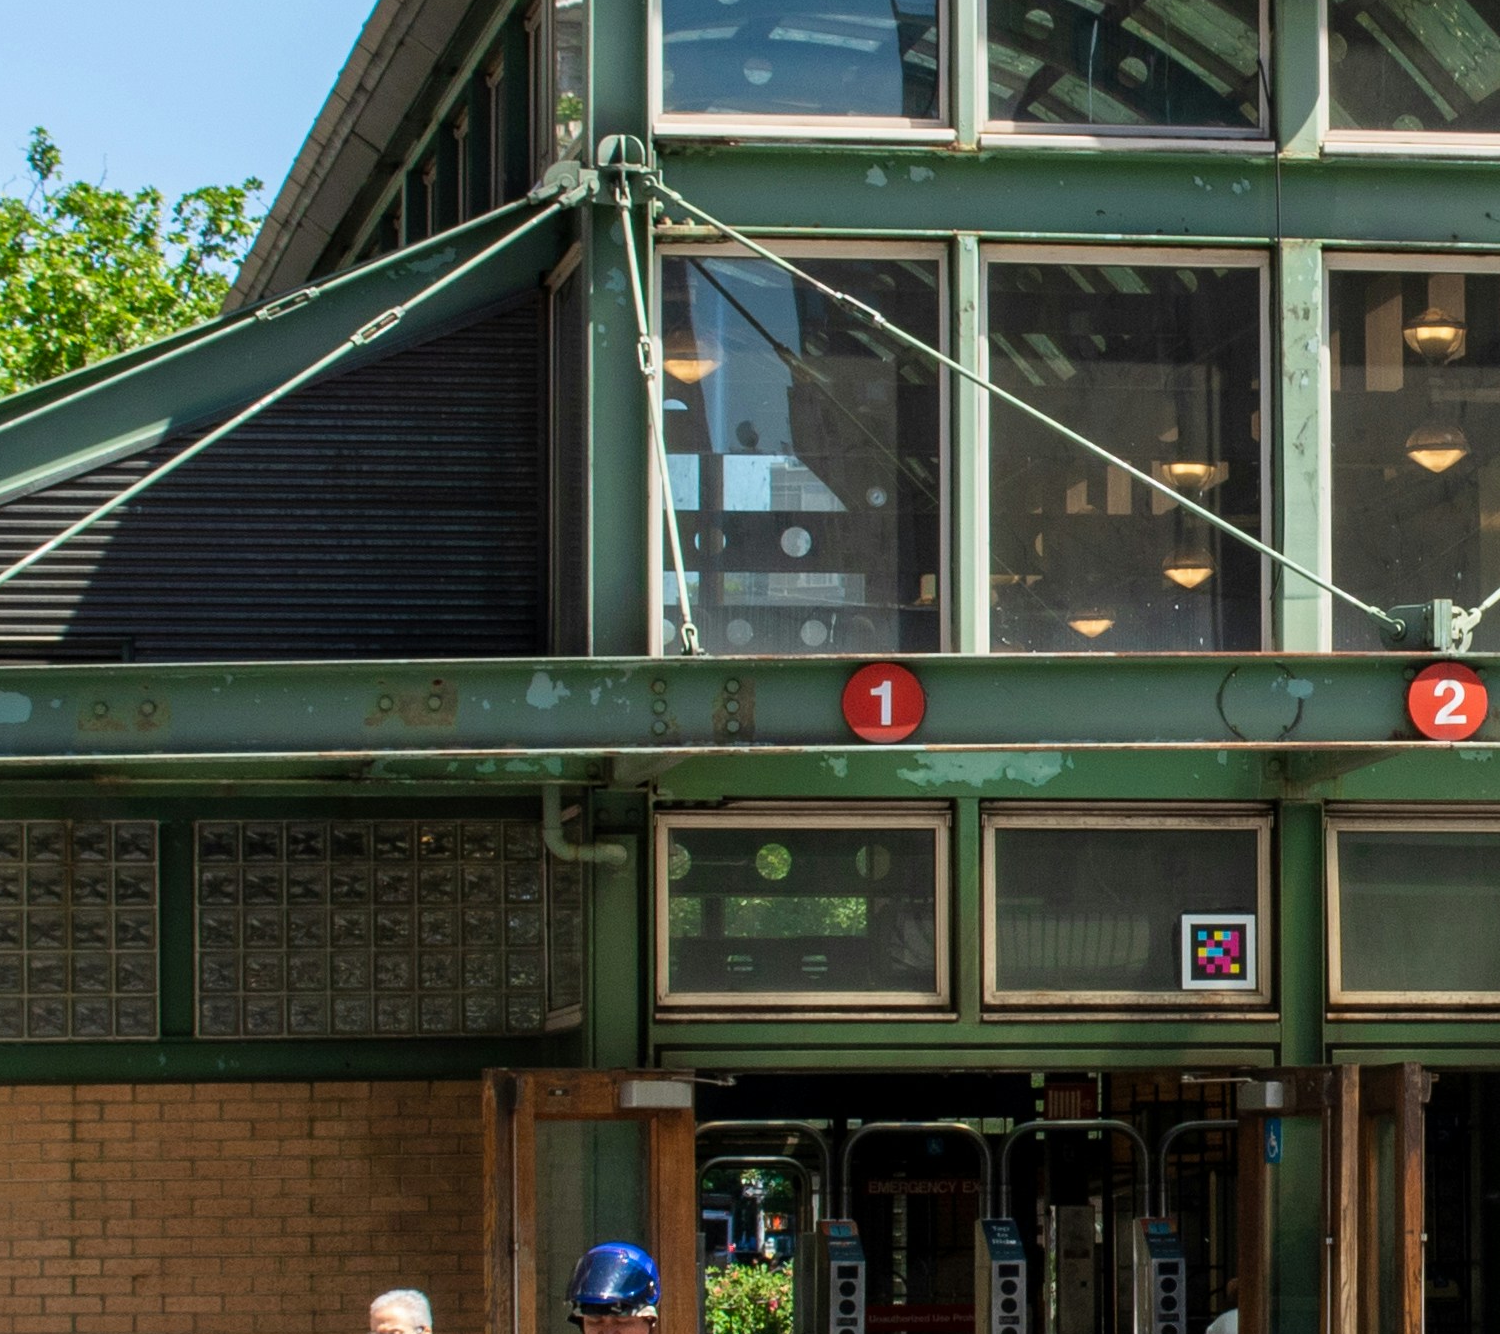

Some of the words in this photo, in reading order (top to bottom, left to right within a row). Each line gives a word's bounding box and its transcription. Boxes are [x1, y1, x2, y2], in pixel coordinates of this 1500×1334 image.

[869, 680, 894, 727] 1
[1432, 679, 1468, 726] 2
[867, 1180, 957, 1194] EMERGENCY
[962, 1180, 981, 1194] EX
